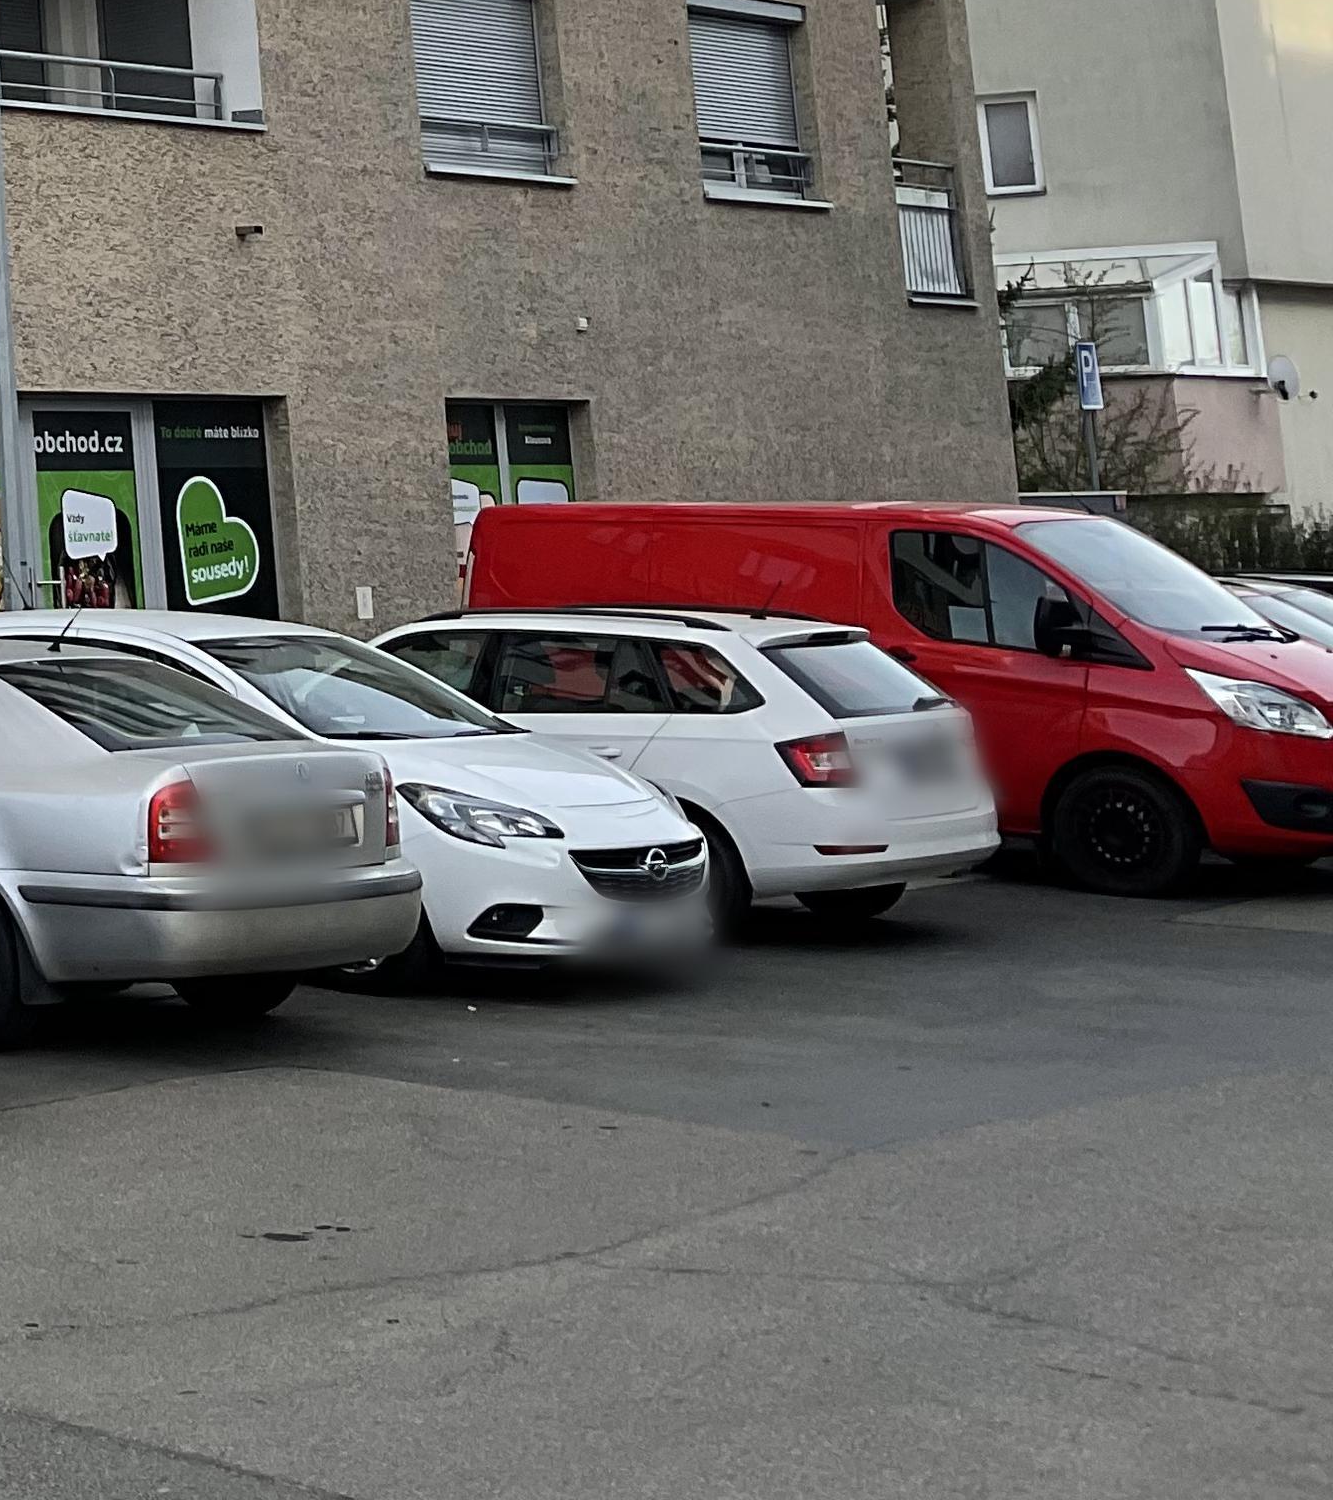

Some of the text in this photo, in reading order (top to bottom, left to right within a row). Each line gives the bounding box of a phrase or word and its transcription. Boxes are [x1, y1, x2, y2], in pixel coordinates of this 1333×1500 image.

[1081, 350, 1093, 388] P
[204, 425, 229, 439] máte
[449, 439, 493, 456] obchod
[185, 520, 218, 538] Máme
[191, 555, 250, 584] sousedy!
